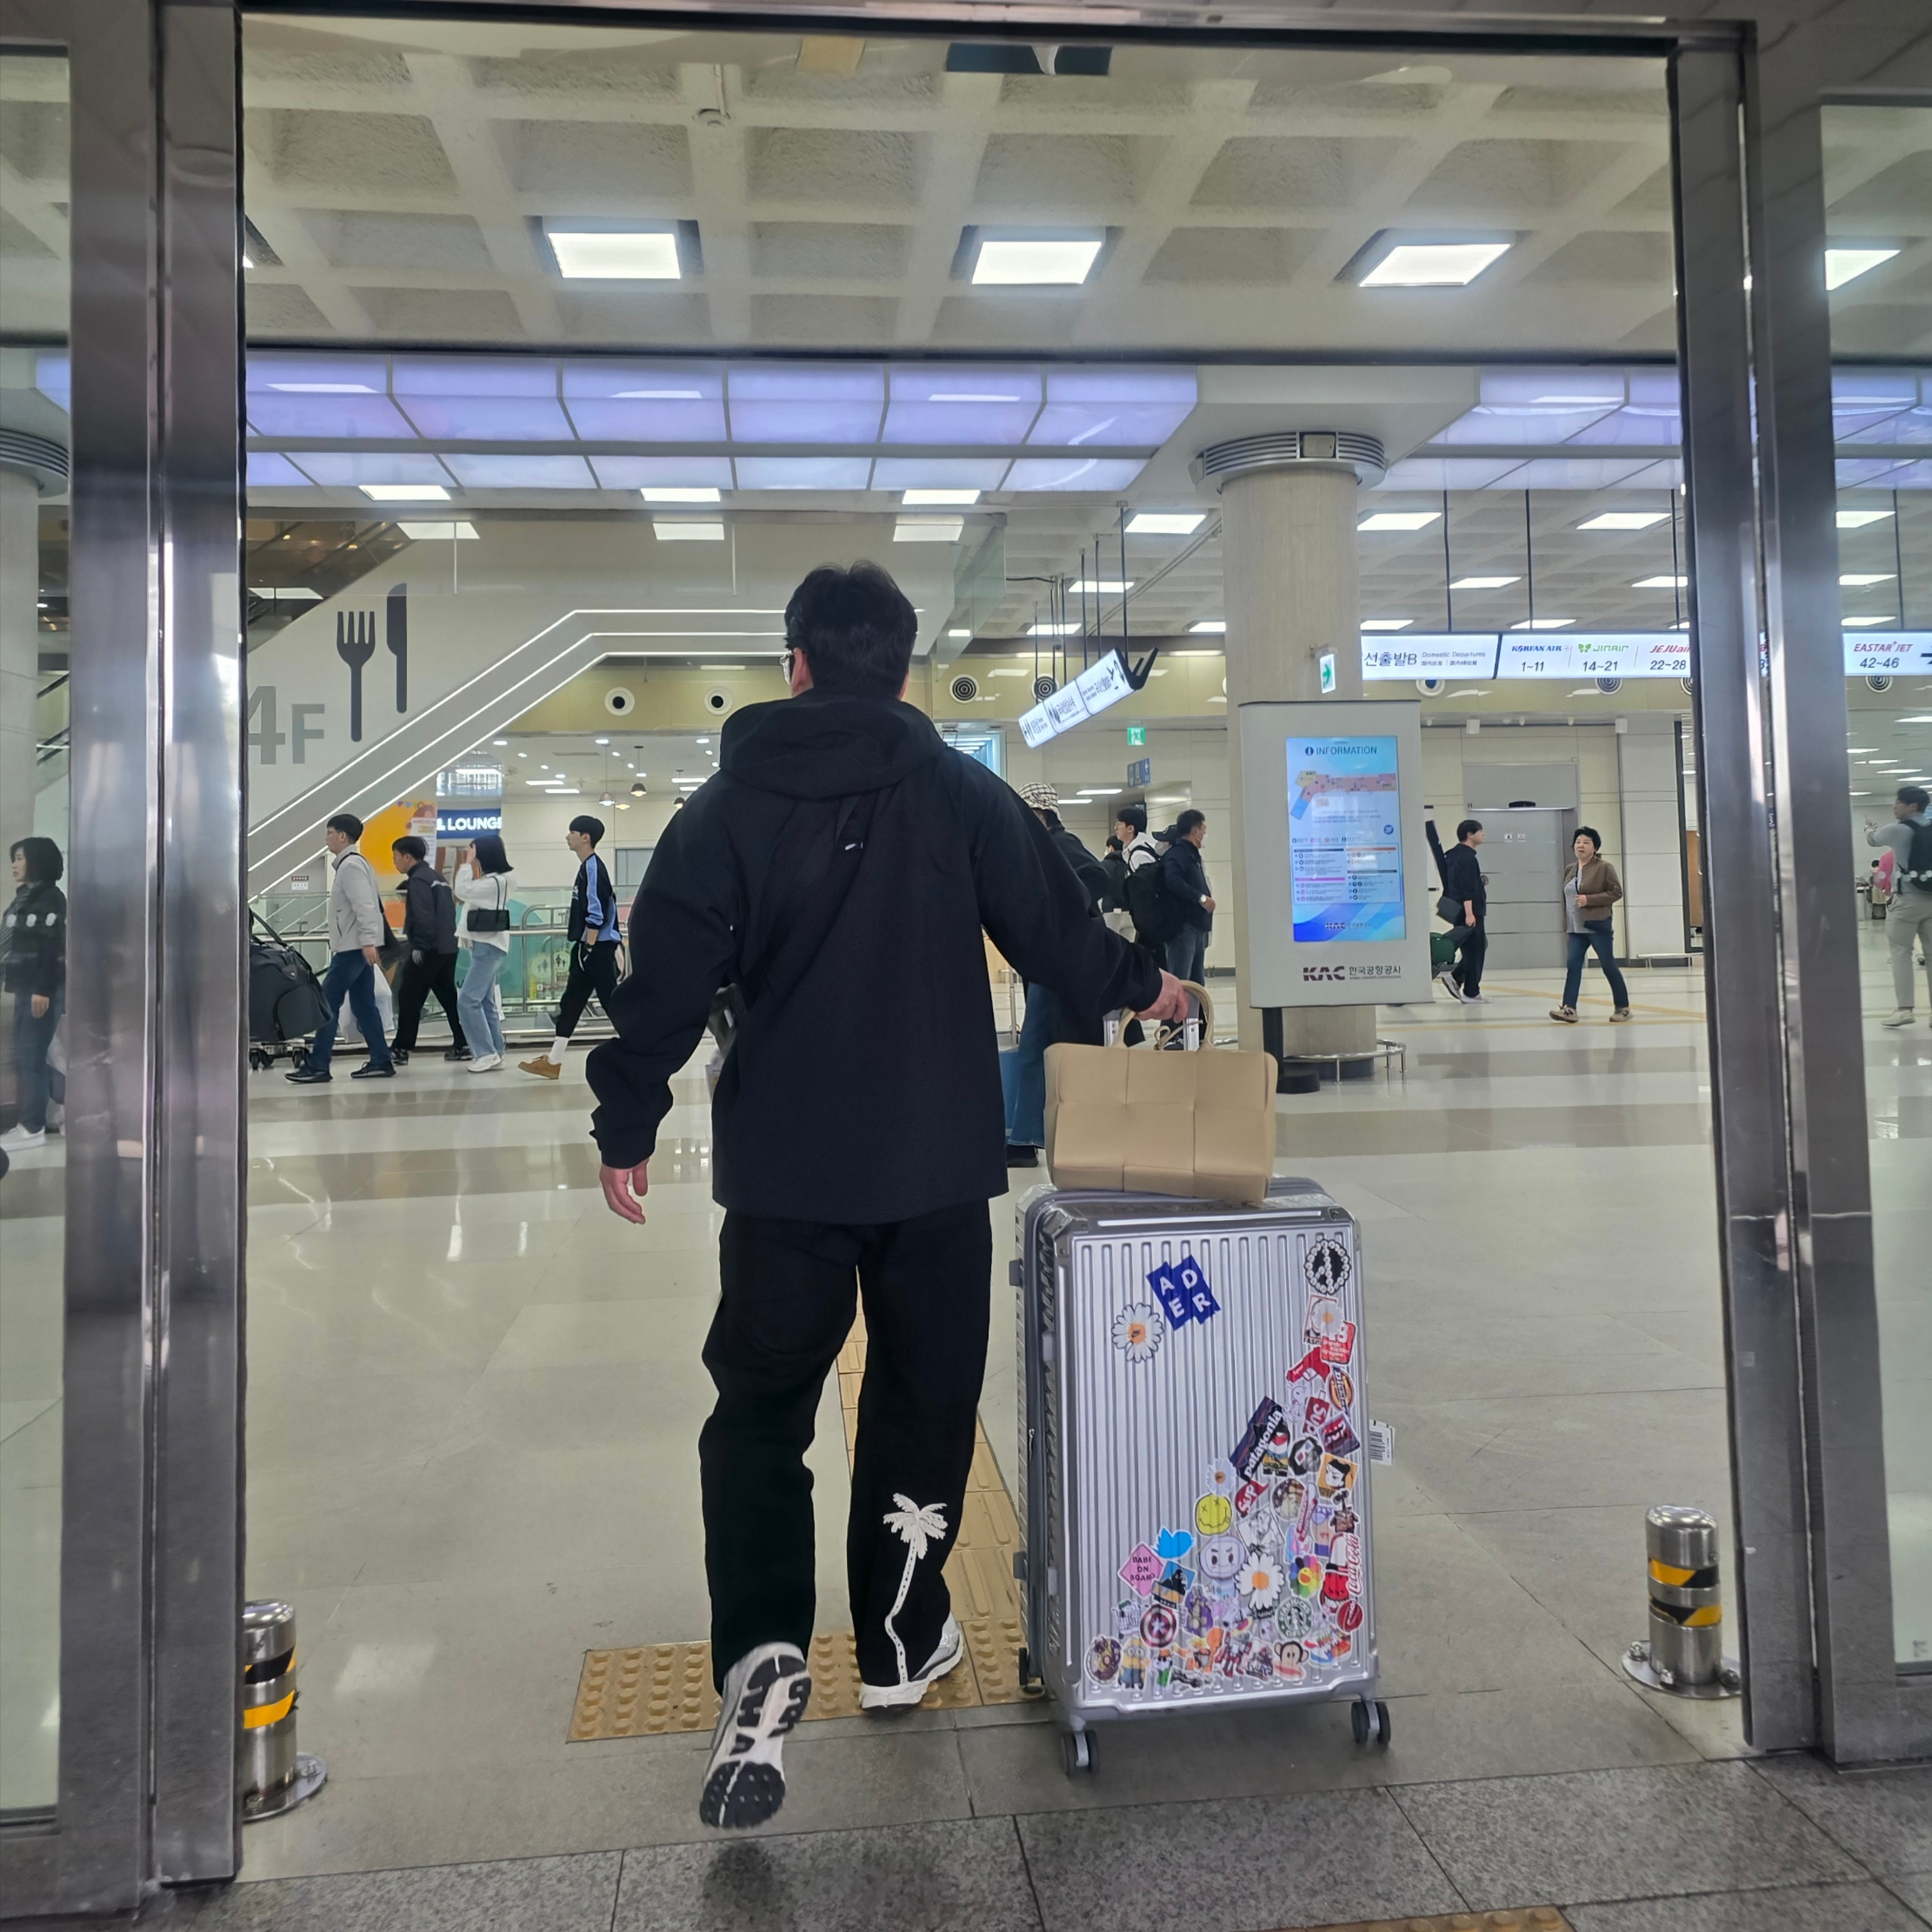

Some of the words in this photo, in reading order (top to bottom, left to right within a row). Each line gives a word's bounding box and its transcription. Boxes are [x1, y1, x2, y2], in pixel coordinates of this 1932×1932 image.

[1853, 643, 1891, 652] EASTAR
[1895, 643, 1913, 652] JET
[1522, 661, 1544, 672] 1~11
[1582, 661, 1618, 671] 14~21
[1649, 660, 1687, 670] 22~28
[1859, 657, 1900, 669] 42~46
[248, 686, 325, 764] 4F
[1316, 746, 1377, 755] INFORMATION
[1303, 966, 1345, 981] KAC
[1349, 965, 1401, 976] 한국공항공사
[1243, 1410, 1283, 1479] patagonia
